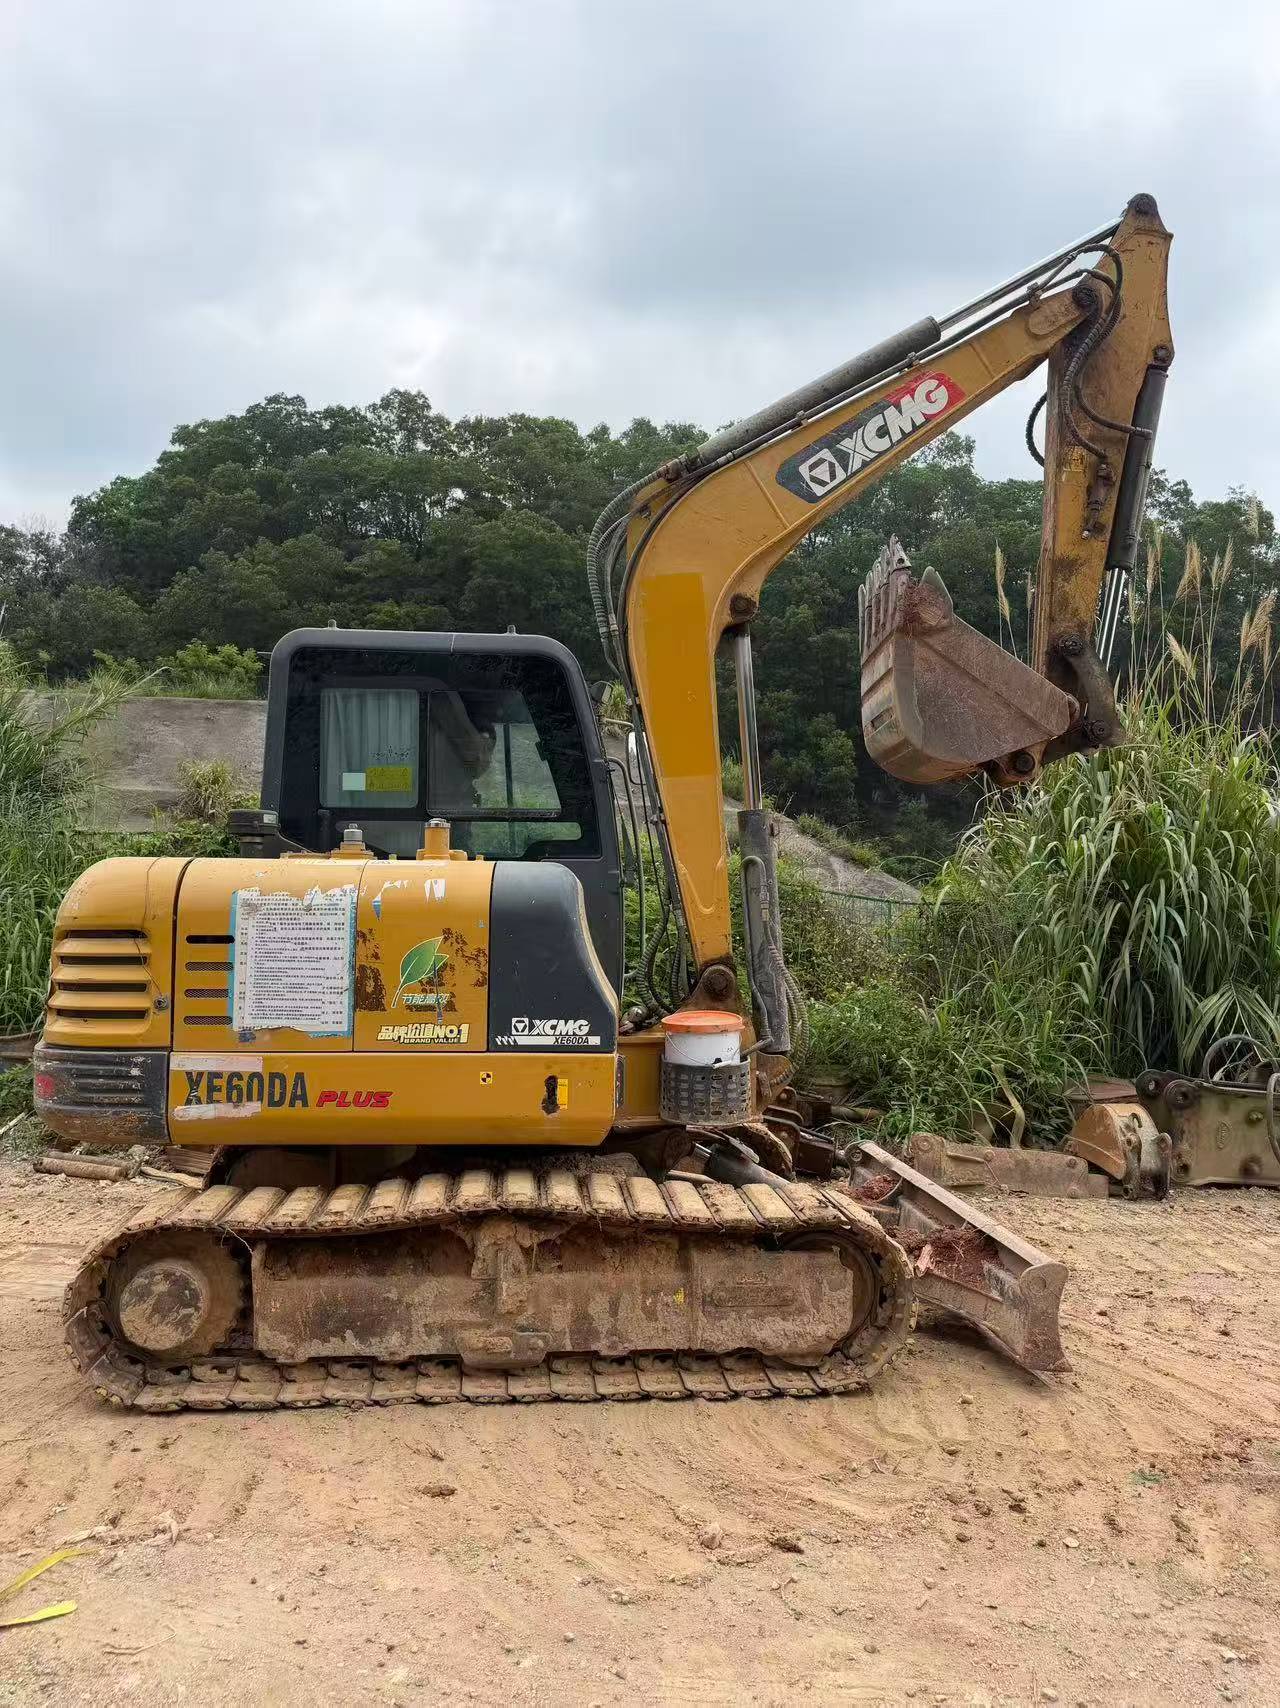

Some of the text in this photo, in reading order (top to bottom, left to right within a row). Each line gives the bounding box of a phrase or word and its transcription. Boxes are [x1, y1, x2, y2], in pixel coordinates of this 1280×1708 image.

[835, 379, 949, 476] XCMG
[529, 1019, 591, 1035] XCMG
[553, 1036, 589, 1045] XE60DA
[184, 1071, 394, 1108] XE60DA PLUS
